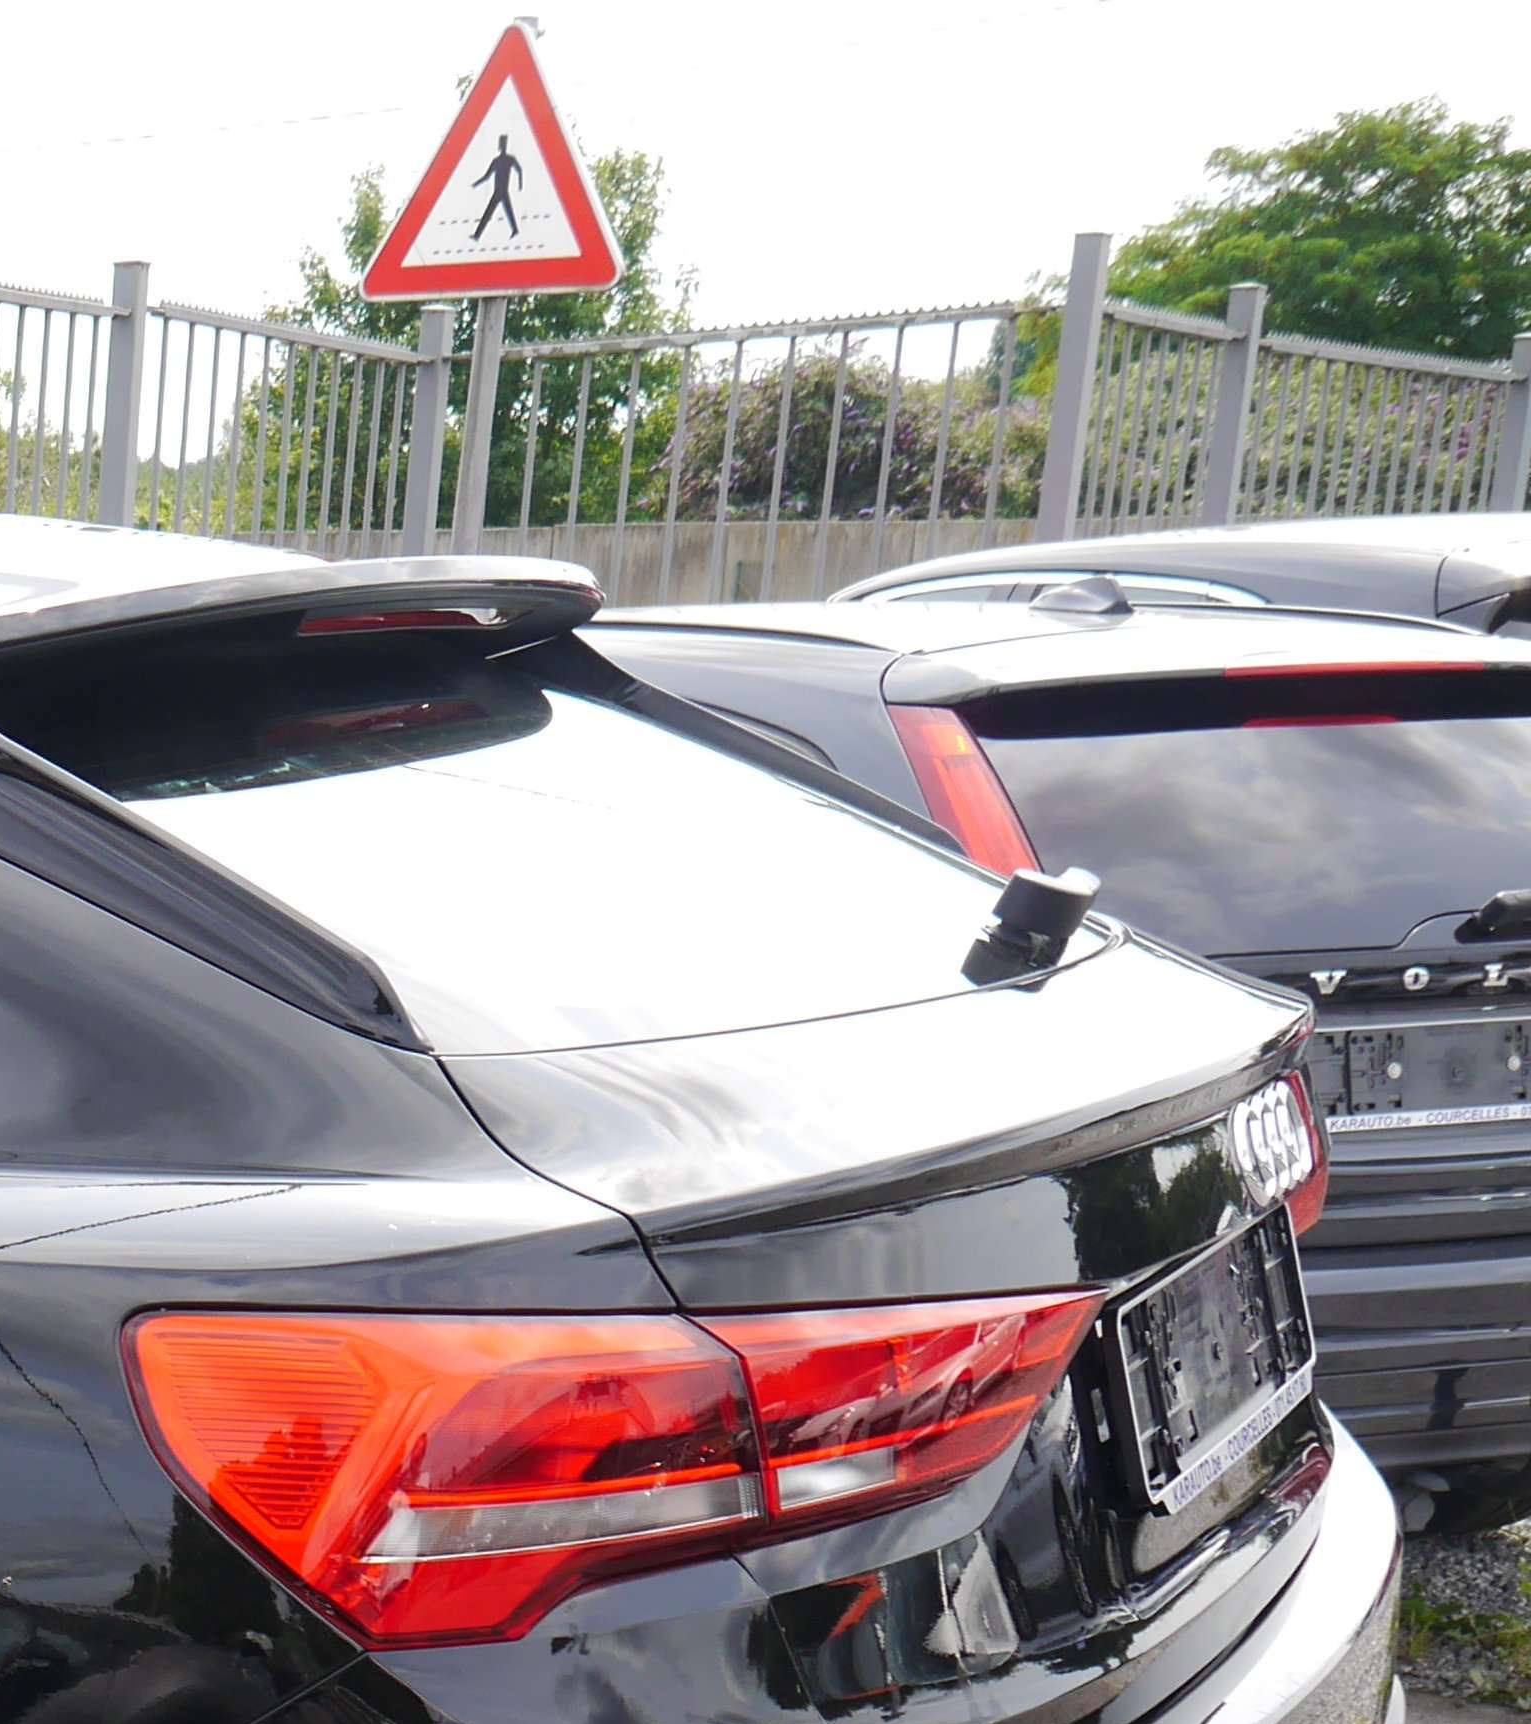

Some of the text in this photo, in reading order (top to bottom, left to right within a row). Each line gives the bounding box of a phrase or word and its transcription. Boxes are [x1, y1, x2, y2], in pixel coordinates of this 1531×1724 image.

[1329, 1116, 1412, 1131] KARAUTO.be
[1426, 1107, 1509, 1124] COURCELLES
[1226, 1406, 1273, 1461] COURCELLES
